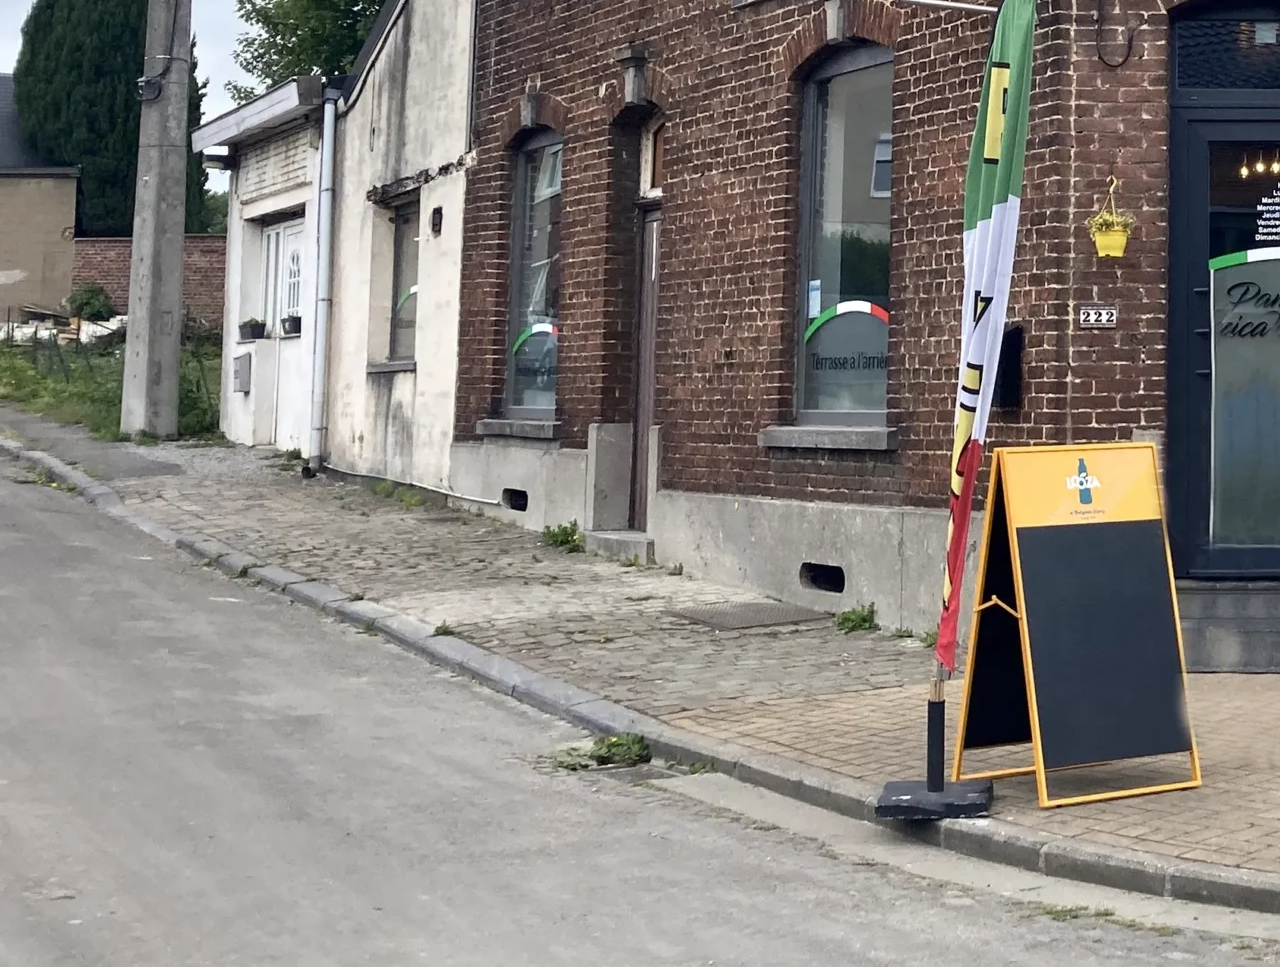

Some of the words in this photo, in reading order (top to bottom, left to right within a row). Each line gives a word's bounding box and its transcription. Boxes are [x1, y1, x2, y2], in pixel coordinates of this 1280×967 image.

[1082, 310, 1114, 322] 222
[812, 352, 848, 370] Terrasse
[1066, 472, 1101, 490] LOOZA
